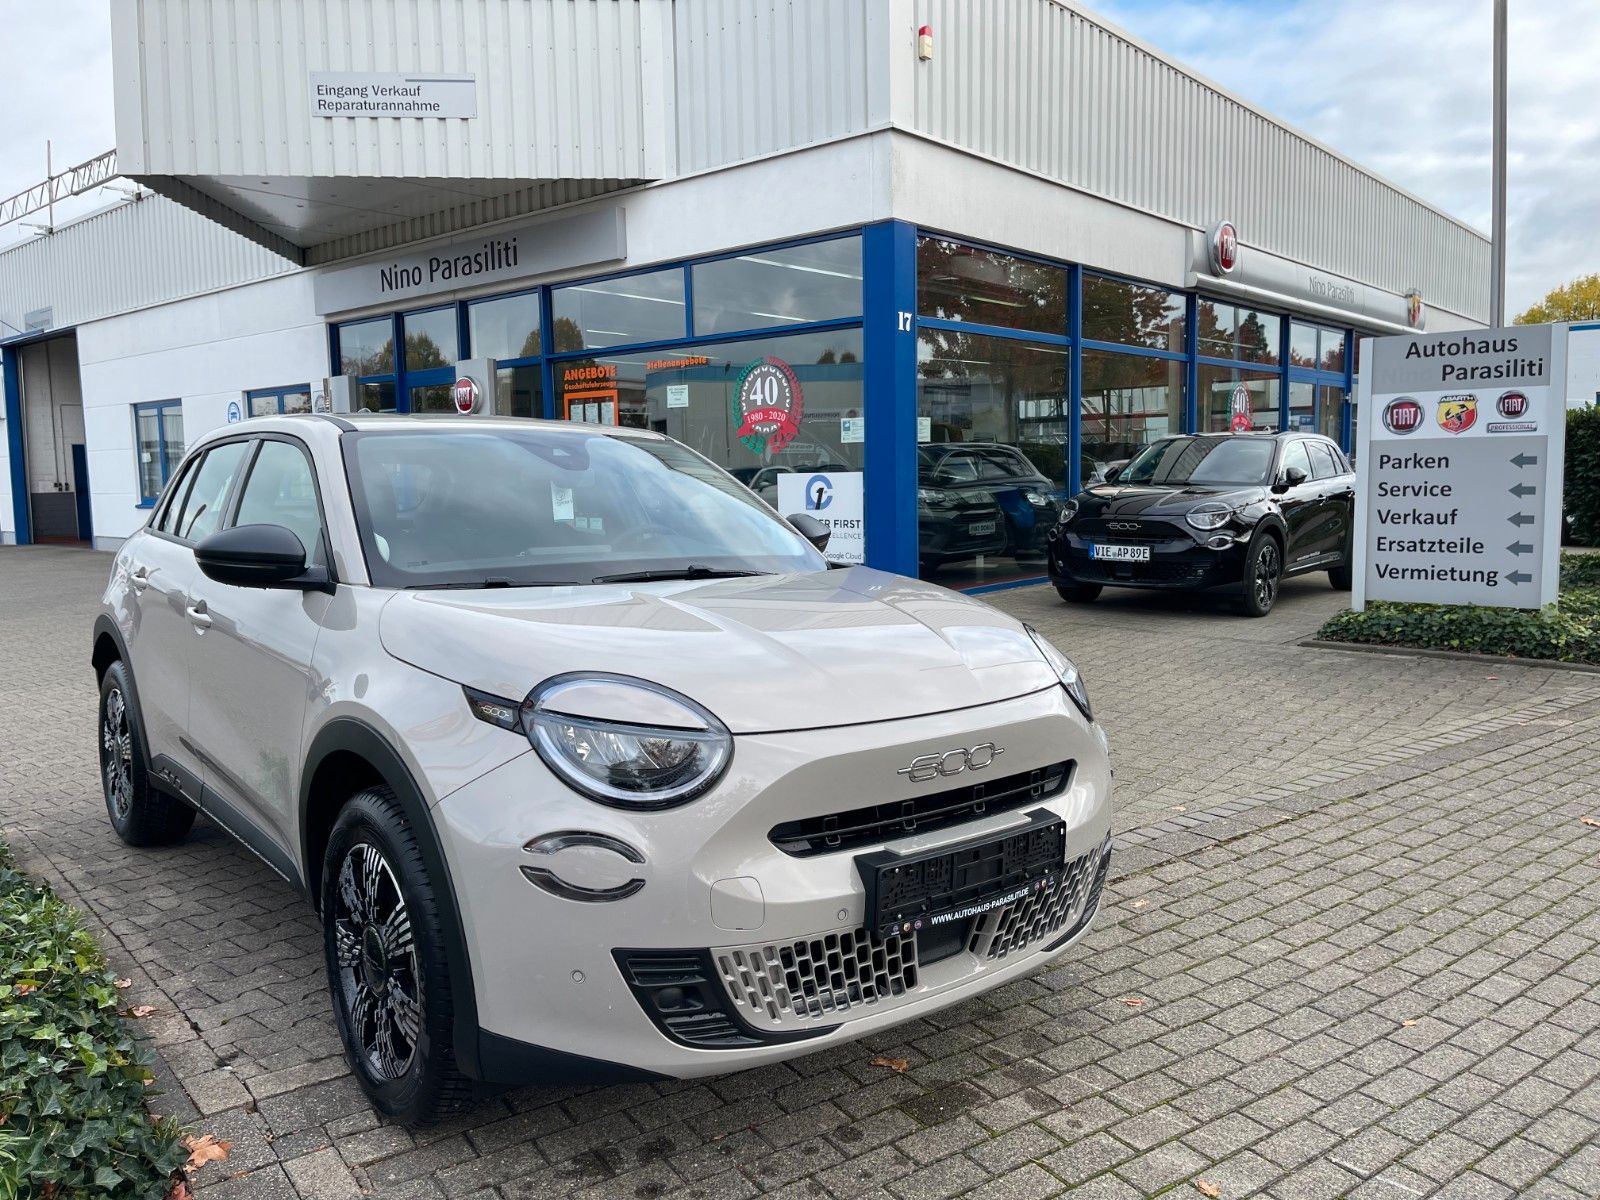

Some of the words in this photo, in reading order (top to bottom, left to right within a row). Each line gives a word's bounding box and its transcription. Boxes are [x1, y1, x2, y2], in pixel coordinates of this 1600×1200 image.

[317, 84, 368, 98] Eingang
[372, 85, 422, 97] Verkauf
[318, 100, 440, 112] Reparaturannahme
[380, 264, 422, 292] Nino
[429, 237, 518, 282] Parasiliti
[1309, 276, 1326, 296] Nino
[898, 311, 912, 332] 17
[1405, 336, 1518, 359] Autohaus
[564, 364, 616, 380] ANGEBOTE
[1441, 358, 1543, 382] Parasiliti
[749, 376, 778, 405] 40
[1234, 392, 1246, 413] 40
[1504, 398, 1523, 412] FIAT
[747, 412, 763, 424] 1980
[769, 411, 786, 421] 2020
[1392, 407, 1416, 426] FIAT
[1490, 423, 1534, 431] PROFESSIONAL
[1379, 453, 1450, 469] Parken
[1378, 481, 1452, 497] Service
[834, 519, 861, 529] FIRST
[1377, 508, 1459, 525] Verkauf
[829, 532, 862, 540] ELLENCE
[1095, 546, 1111, 558] VIE
[1376, 536, 1484, 554] Ersatzteile
[845, 551, 862, 560] Cloud
[1375, 563, 1499, 587] Vermietung
[482, 704, 507, 719] 600
[907, 741, 997, 783] 600
